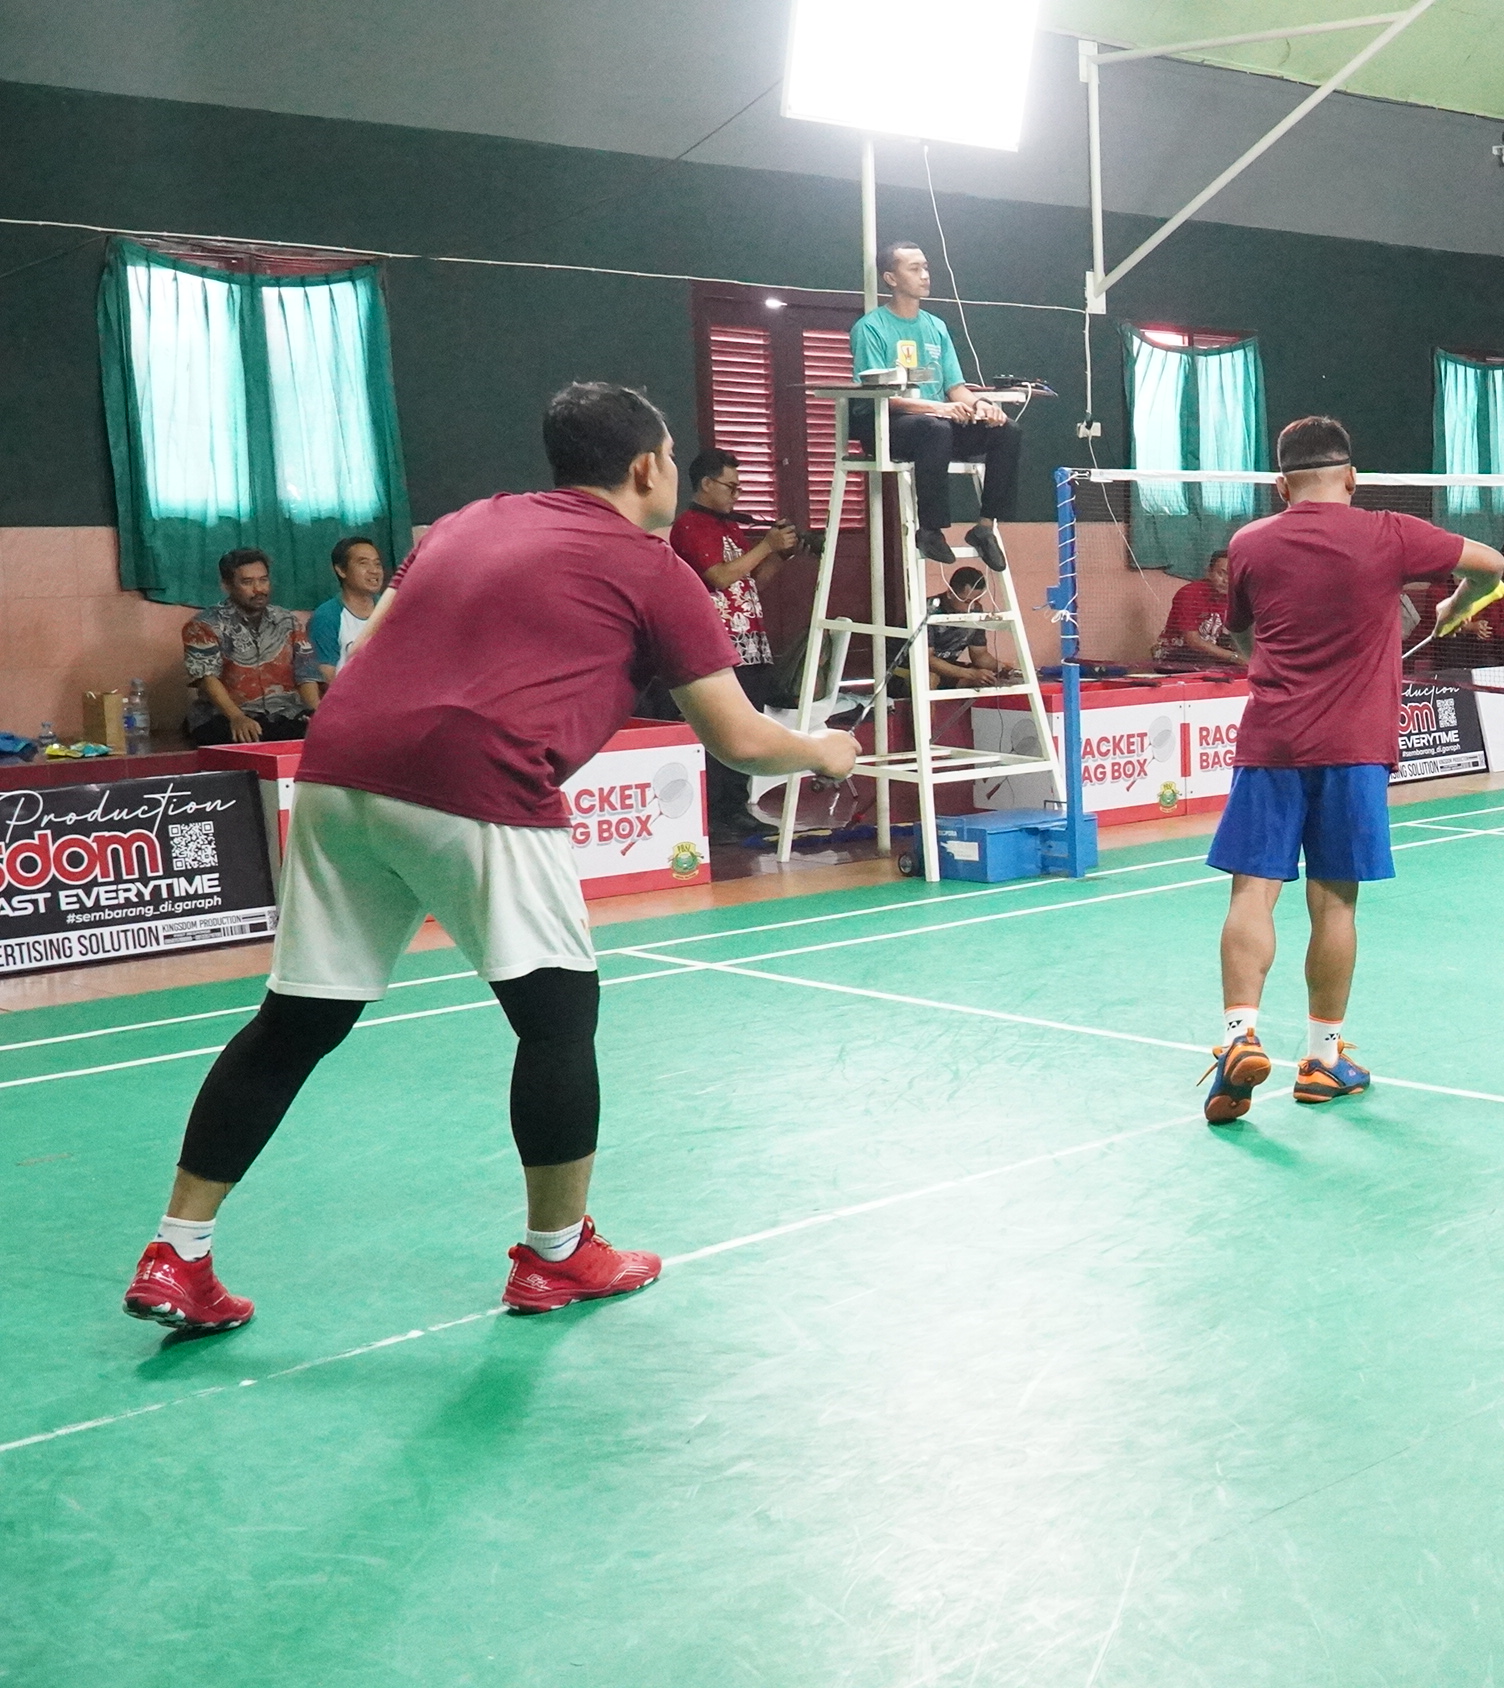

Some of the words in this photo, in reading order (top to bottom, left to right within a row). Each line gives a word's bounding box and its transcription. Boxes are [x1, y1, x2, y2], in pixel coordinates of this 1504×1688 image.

[1081, 732, 1149, 760] ACKET
[1199, 723, 1239, 747] RAC
[1398, 730, 1460, 749] EVERYTIME
[1082, 764, 1107, 784] AG
[1110, 757, 1149, 780] BOX
[1200, 750, 1236, 771] BAG
[1408, 761, 1440, 777] SOLUTION
[560, 782, 652, 817] CKET
[597, 814, 654, 843] BOX
[58, 872, 222, 912] EVERYTIME
[66, 896, 222, 925] #sembarang_di.garaph
[162, 921, 198, 933] KINGSDOM
[199, 915, 242, 928] PRODUCTION
[0, 936, 73, 968] RTISING
[78, 926, 161, 957] SOLUTION
